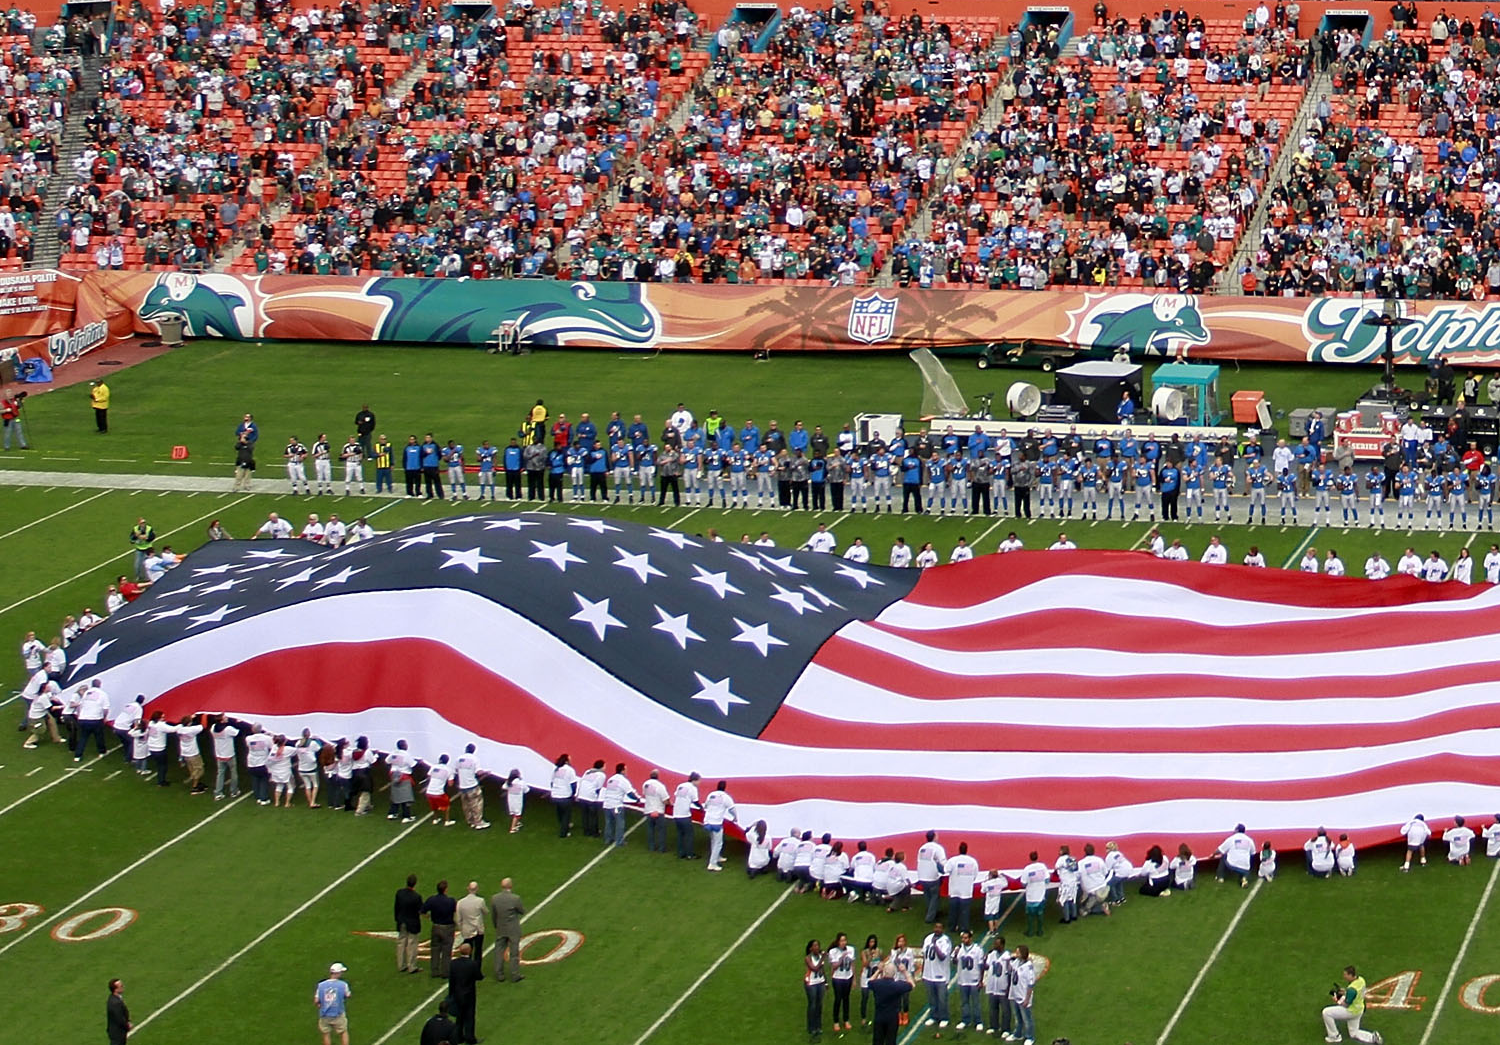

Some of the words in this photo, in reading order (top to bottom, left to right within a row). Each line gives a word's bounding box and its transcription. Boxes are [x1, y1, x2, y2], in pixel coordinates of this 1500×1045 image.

[174, 276, 188, 288] M
[1163, 297, 1178, 308] M
[854, 315, 888, 338] NFL
[49, 320, 108, 366] Dolphins
